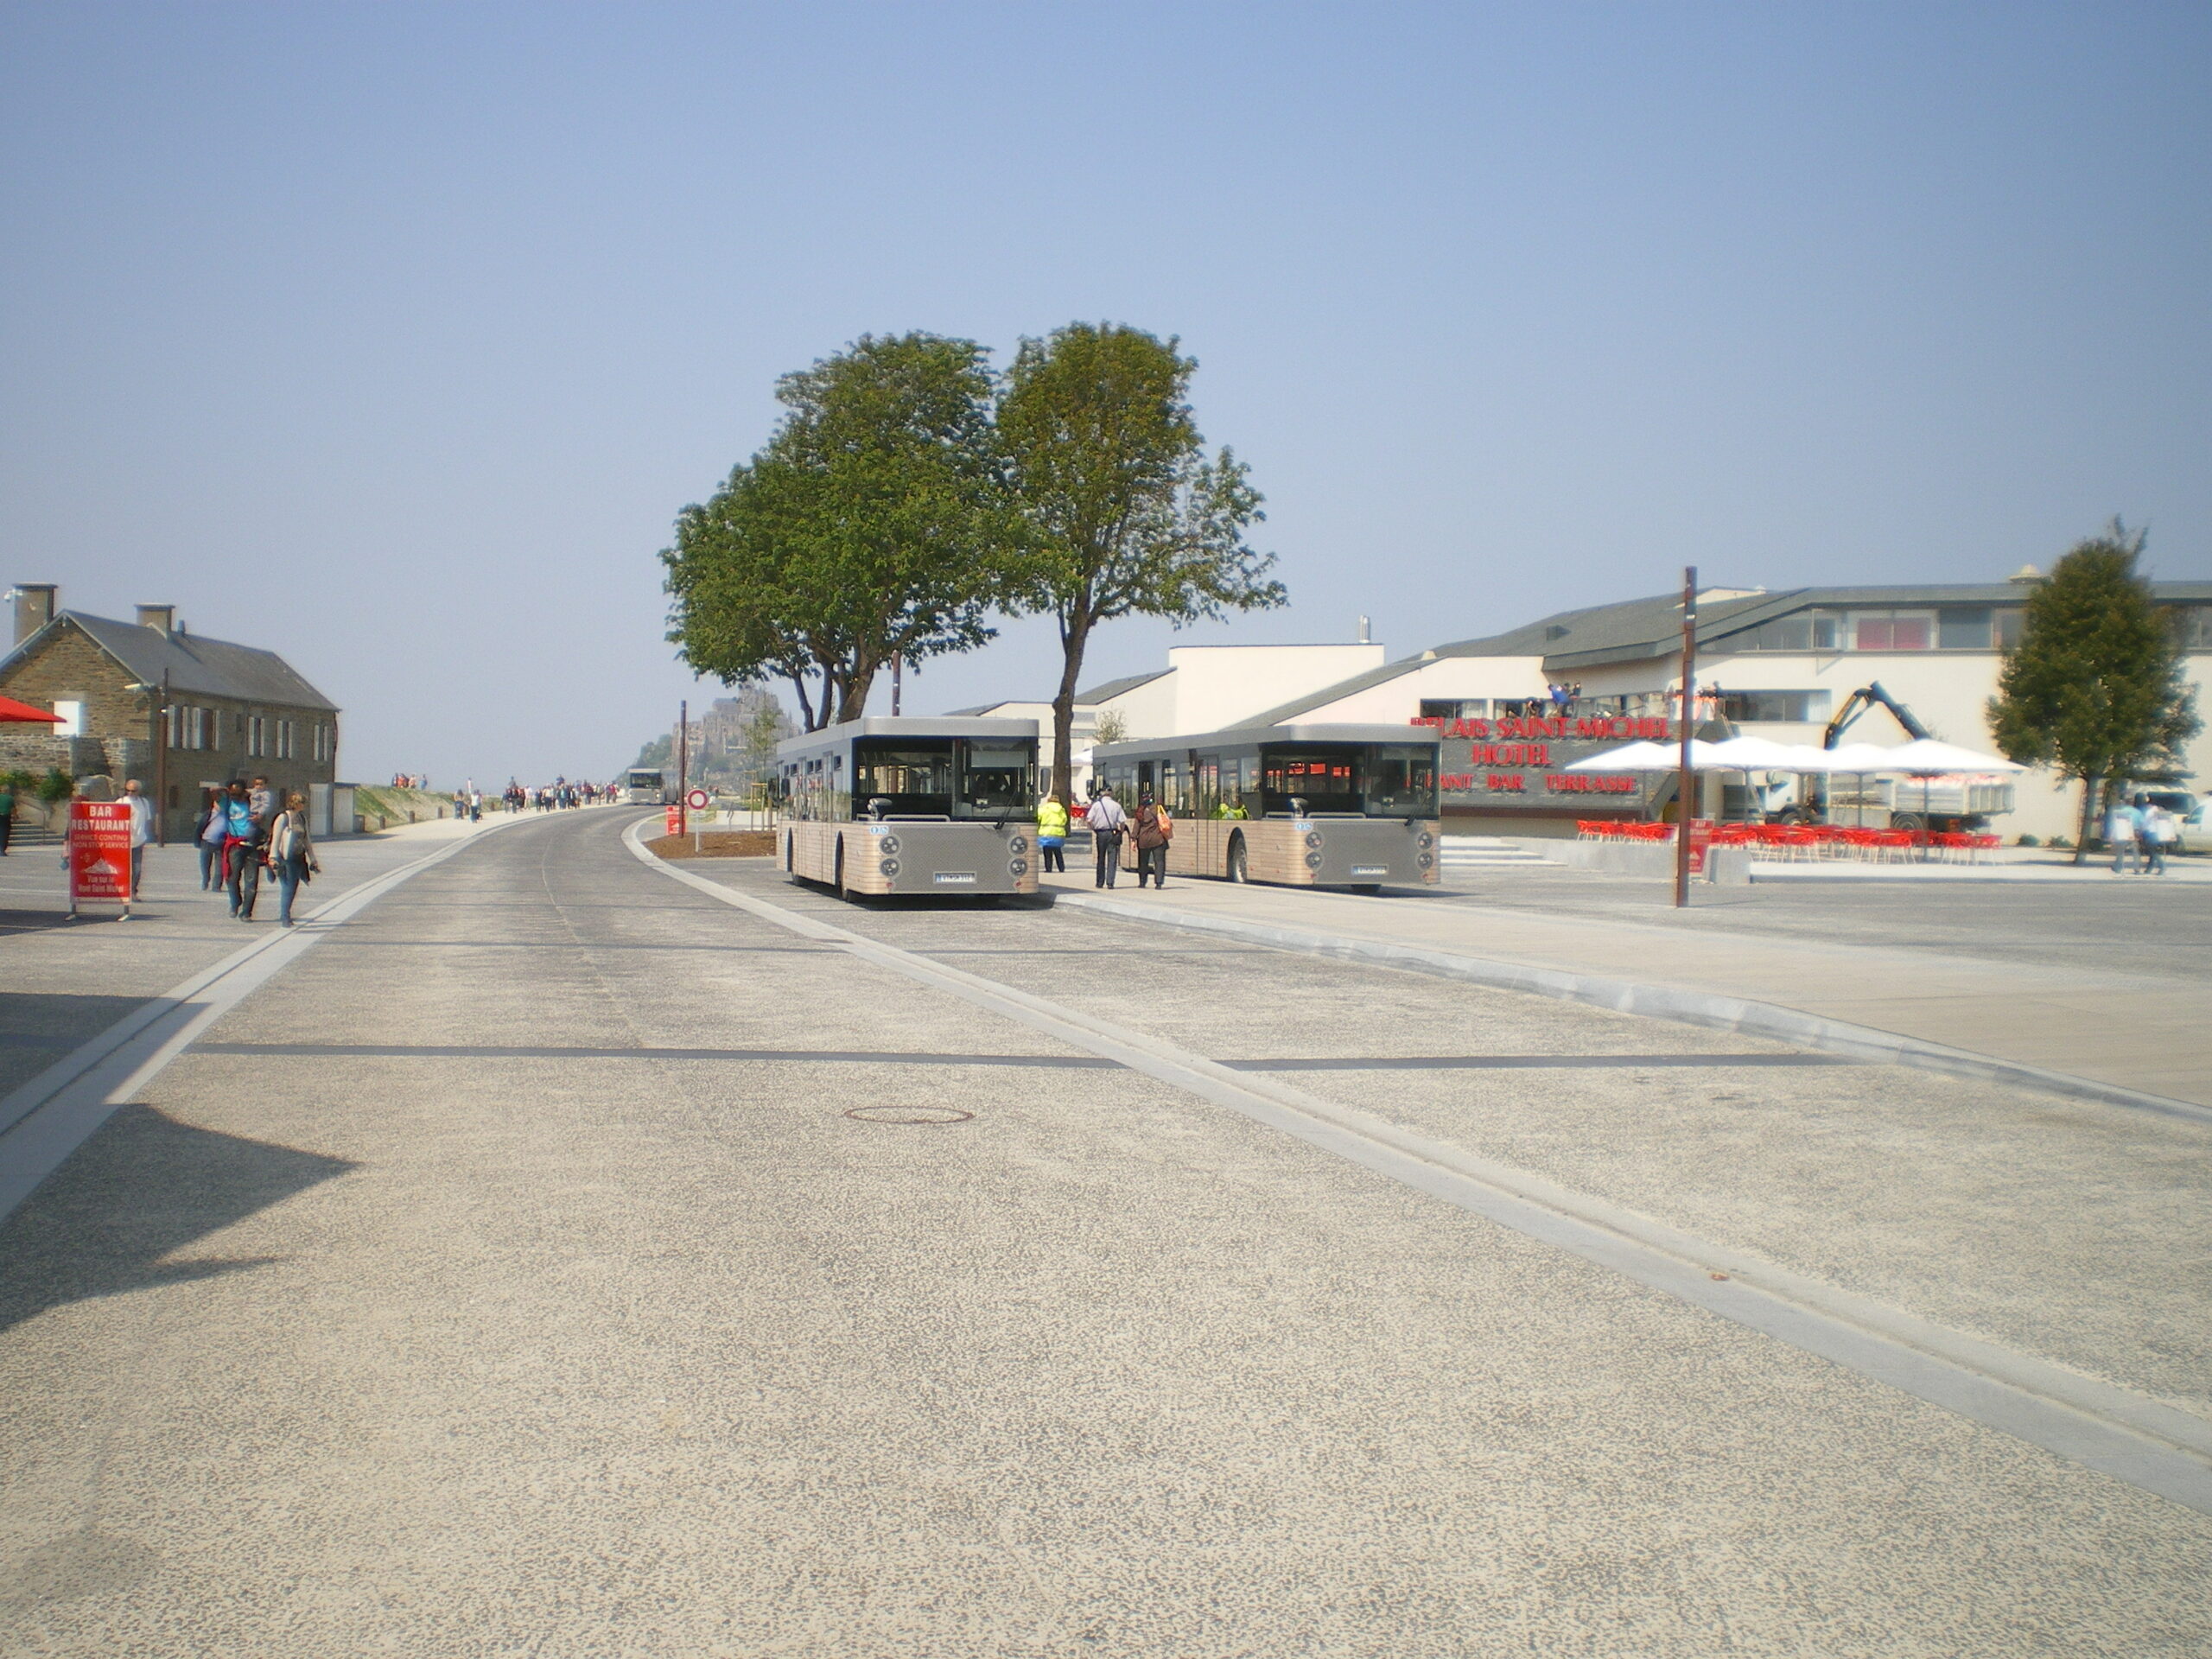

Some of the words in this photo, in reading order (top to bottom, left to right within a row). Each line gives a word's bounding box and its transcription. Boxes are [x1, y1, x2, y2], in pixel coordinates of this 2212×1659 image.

[1471, 744, 1553, 765] HOTEL
[1486, 773, 1526, 790] BAR
[1544, 773, 1637, 792] TERRASSE
[89, 806, 111, 817] BAR
[72, 820, 130, 830] RESTAURANT
[105, 841, 130, 849] SERVICE
